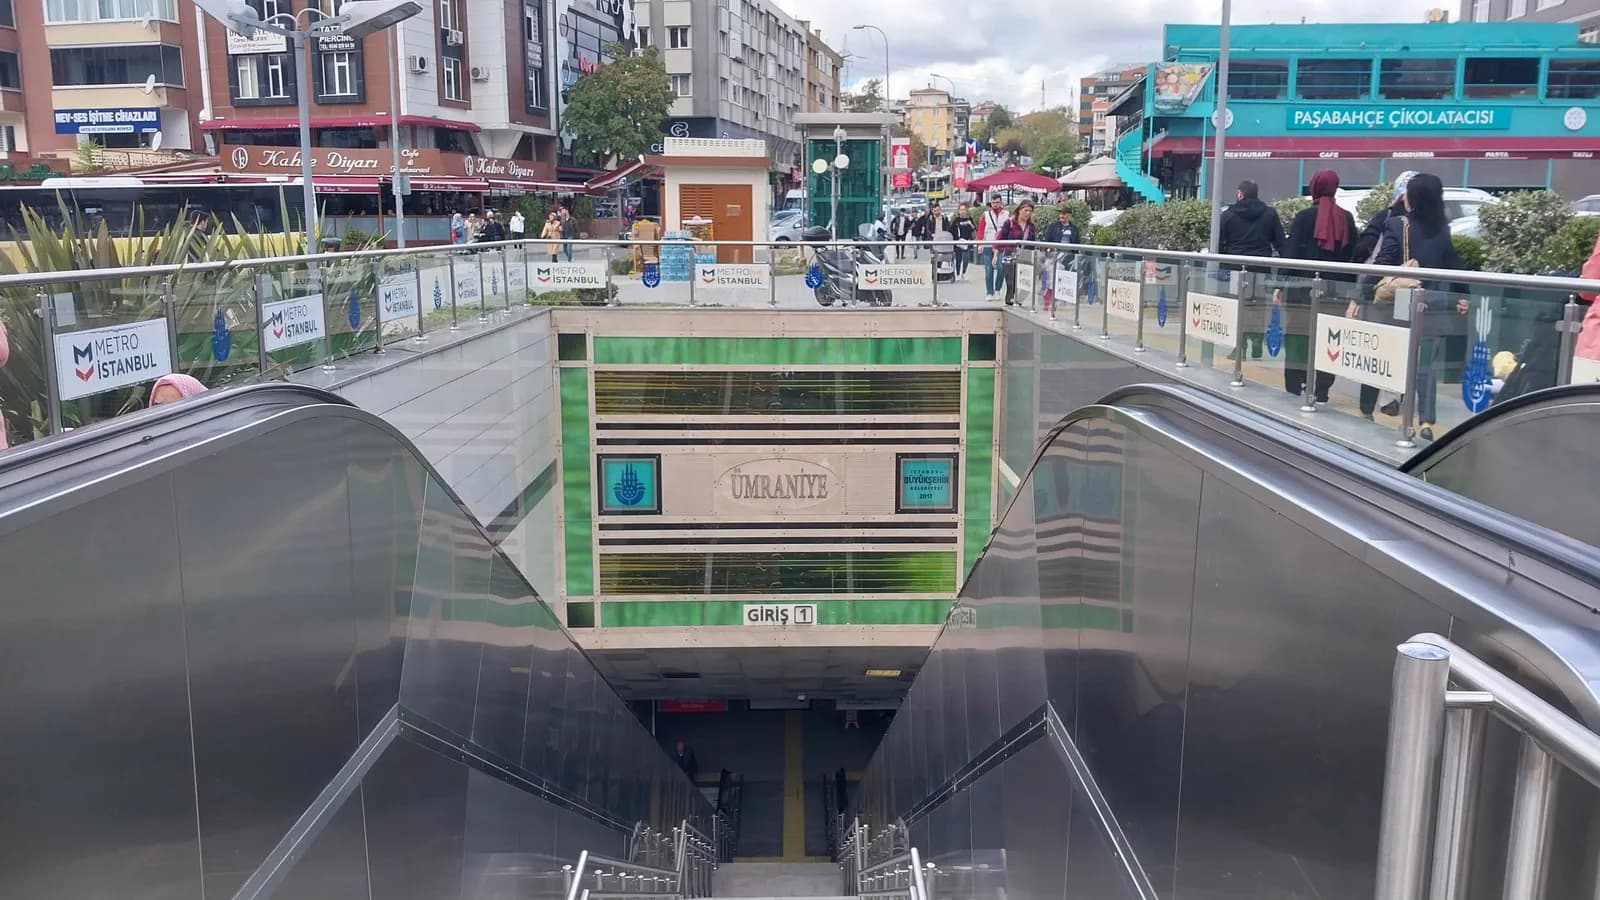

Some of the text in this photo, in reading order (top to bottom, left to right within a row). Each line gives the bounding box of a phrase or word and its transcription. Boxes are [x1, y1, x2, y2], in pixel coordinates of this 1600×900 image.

[114, 109, 157, 122] CİHAZLARI
[1294, 107, 1494, 128] PAŞABAHÇE ÇİKOLATACISI
[258, 150, 378, 173] Kahe Diyarı
[508, 160, 535, 178] Diyarı
[552, 267, 586, 275] METRO
[553, 275, 599, 285] İSTANBUL
[717, 267, 749, 276] METRO
[879, 268, 912, 276] METRO
[717, 276, 763, 285] İSTANBUL
[879, 276, 925, 286] İSTANBUL
[283, 304, 309, 321] METRO
[1201, 302, 1223, 317] METRO
[284, 317, 319, 339] İSTANBUL
[1201, 318, 1230, 337] İSTANBUL
[95, 333, 140, 356] METRO
[1342, 329, 1379, 350] METRO
[97, 352, 158, 380] İSTANBUL
[1341, 349, 1393, 378] İSTANBUL
[730, 467, 828, 499] ÜMRANİYE
[903, 474, 950, 486] BÜYÜKŞEHİR
[748, 605, 807, 625] GİRİŞ 1
